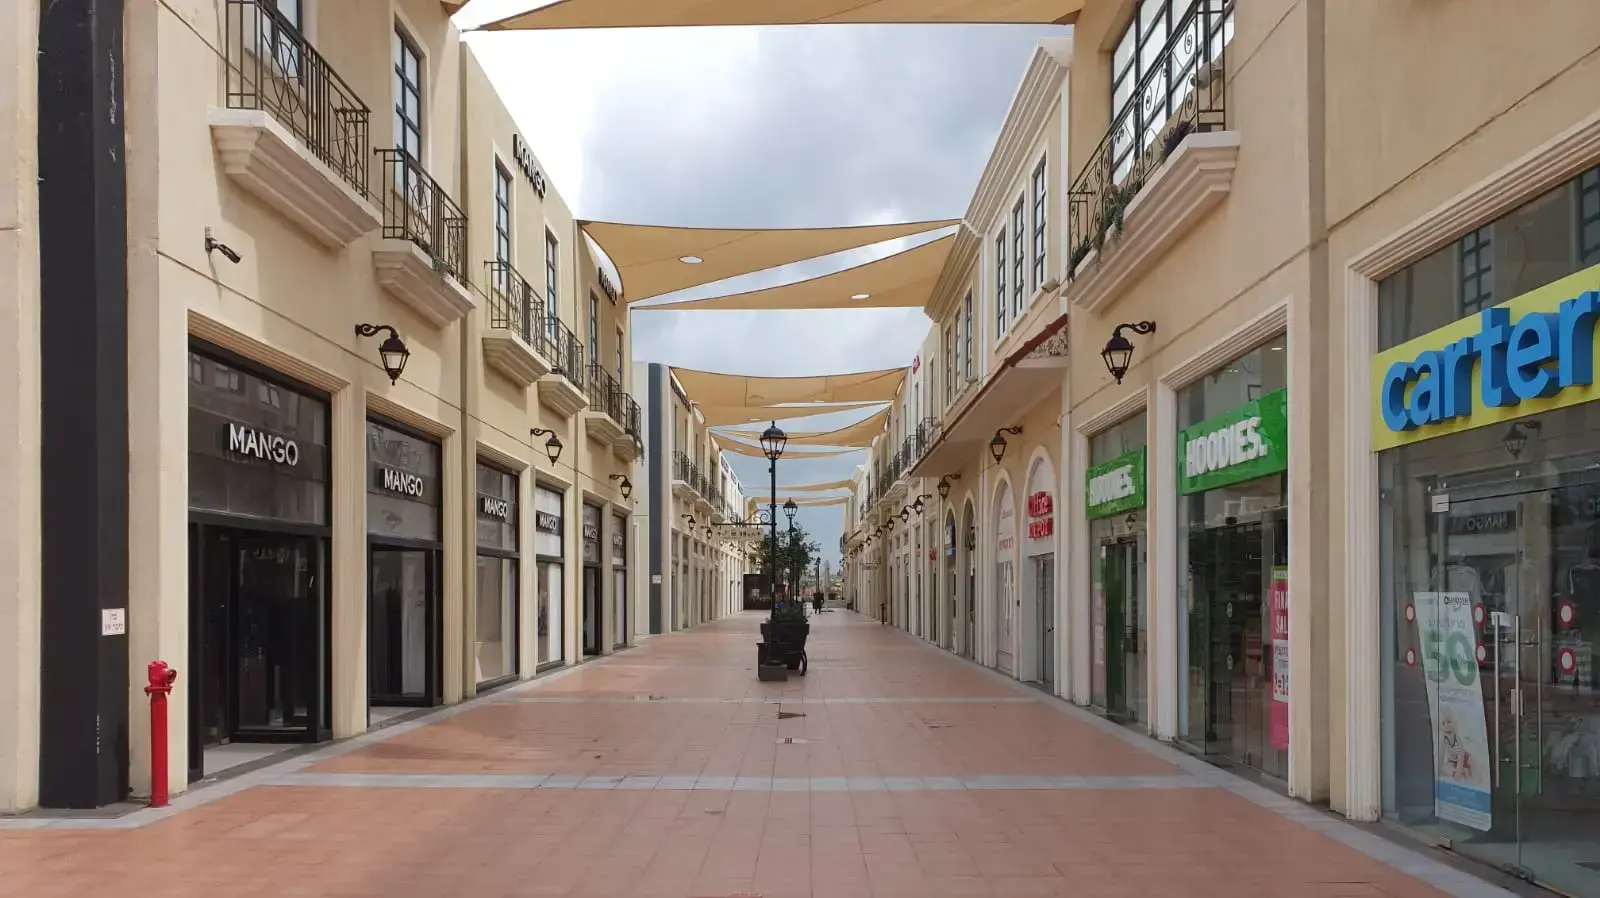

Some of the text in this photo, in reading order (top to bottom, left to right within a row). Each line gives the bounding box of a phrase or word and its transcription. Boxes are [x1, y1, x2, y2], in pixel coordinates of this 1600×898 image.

[512, 133, 546, 199] MANGO
[1381, 289, 1600, 433] carter
[229, 422, 298, 467] MANGO
[1186, 416, 1268, 478] HOODIES.
[383, 467, 424, 497] MANGO
[484, 496, 508, 518] MANGO
[539, 512, 557, 530] MANGO
[1274, 590, 1288, 610] FINA
[1276, 615, 1288, 635] SAL
